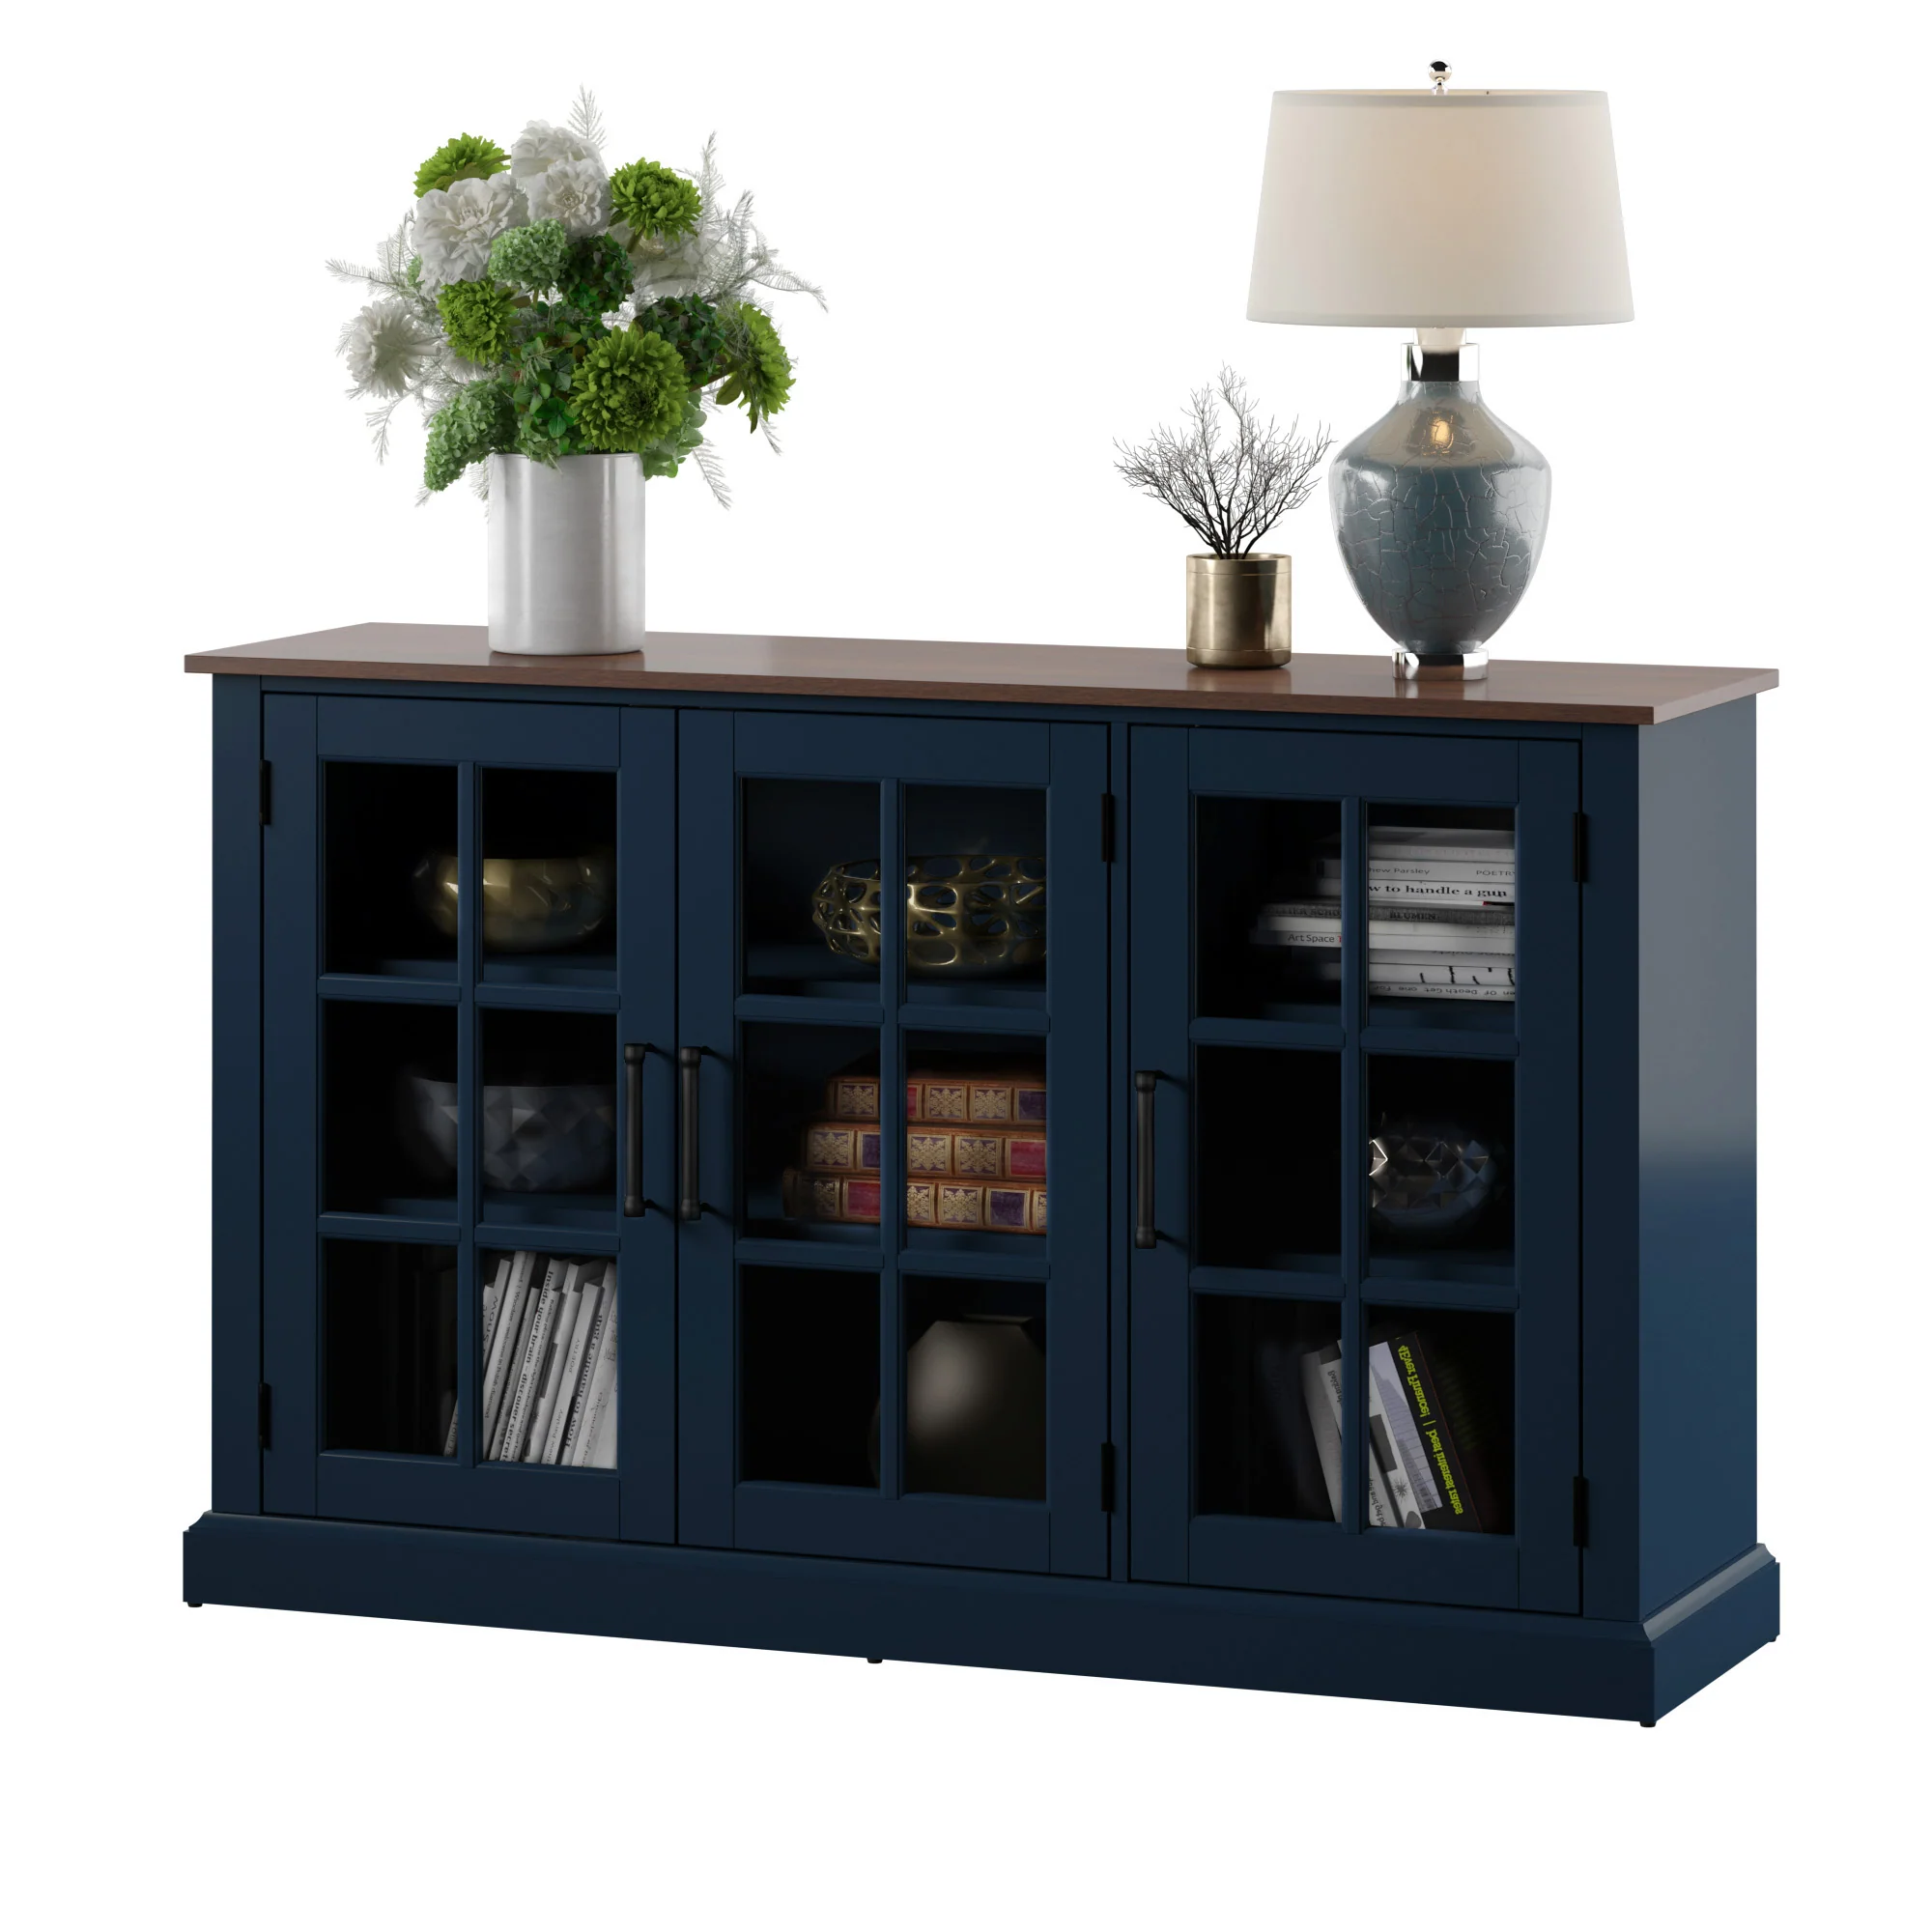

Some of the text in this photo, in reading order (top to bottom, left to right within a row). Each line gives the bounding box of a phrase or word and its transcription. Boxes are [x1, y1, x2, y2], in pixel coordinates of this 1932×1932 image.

[1406, 885, 1460, 895] handle
[1288, 933, 1305, 942] Art
[1306, 934, 1335, 943] Space
[1446, 986, 1478, 995] Death
[543, 1271, 554, 1305] Inside
[532, 1307, 544, 1333] your
[526, 1334, 538, 1363] brain
[514, 1374, 527, 1421] discover
[565, 1416, 577, 1447] How
[574, 1400, 581, 1413] to
[578, 1351, 591, 1398] handle
